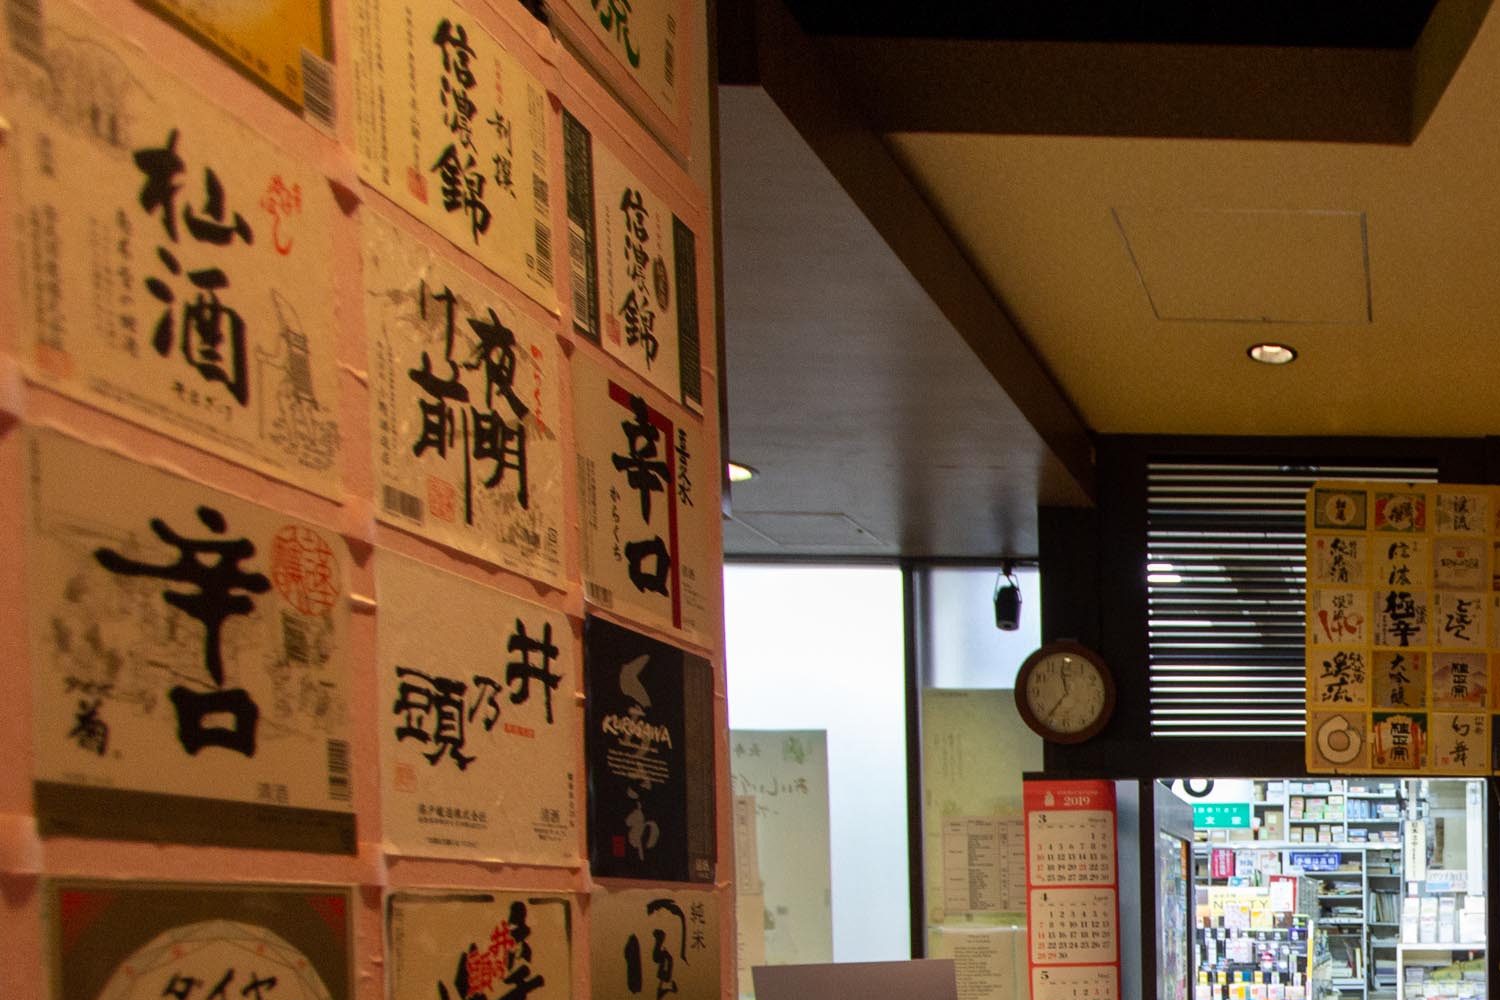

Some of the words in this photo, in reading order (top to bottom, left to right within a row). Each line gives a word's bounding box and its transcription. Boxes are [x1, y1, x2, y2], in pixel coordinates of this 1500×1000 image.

[612, 395, 674, 597] 辛口
[94, 505, 272, 758] 辛口
[1063, 796, 1090, 807] 2019
[1038, 814, 1047, 823] 3
[1040, 970, 1049, 979] 5
